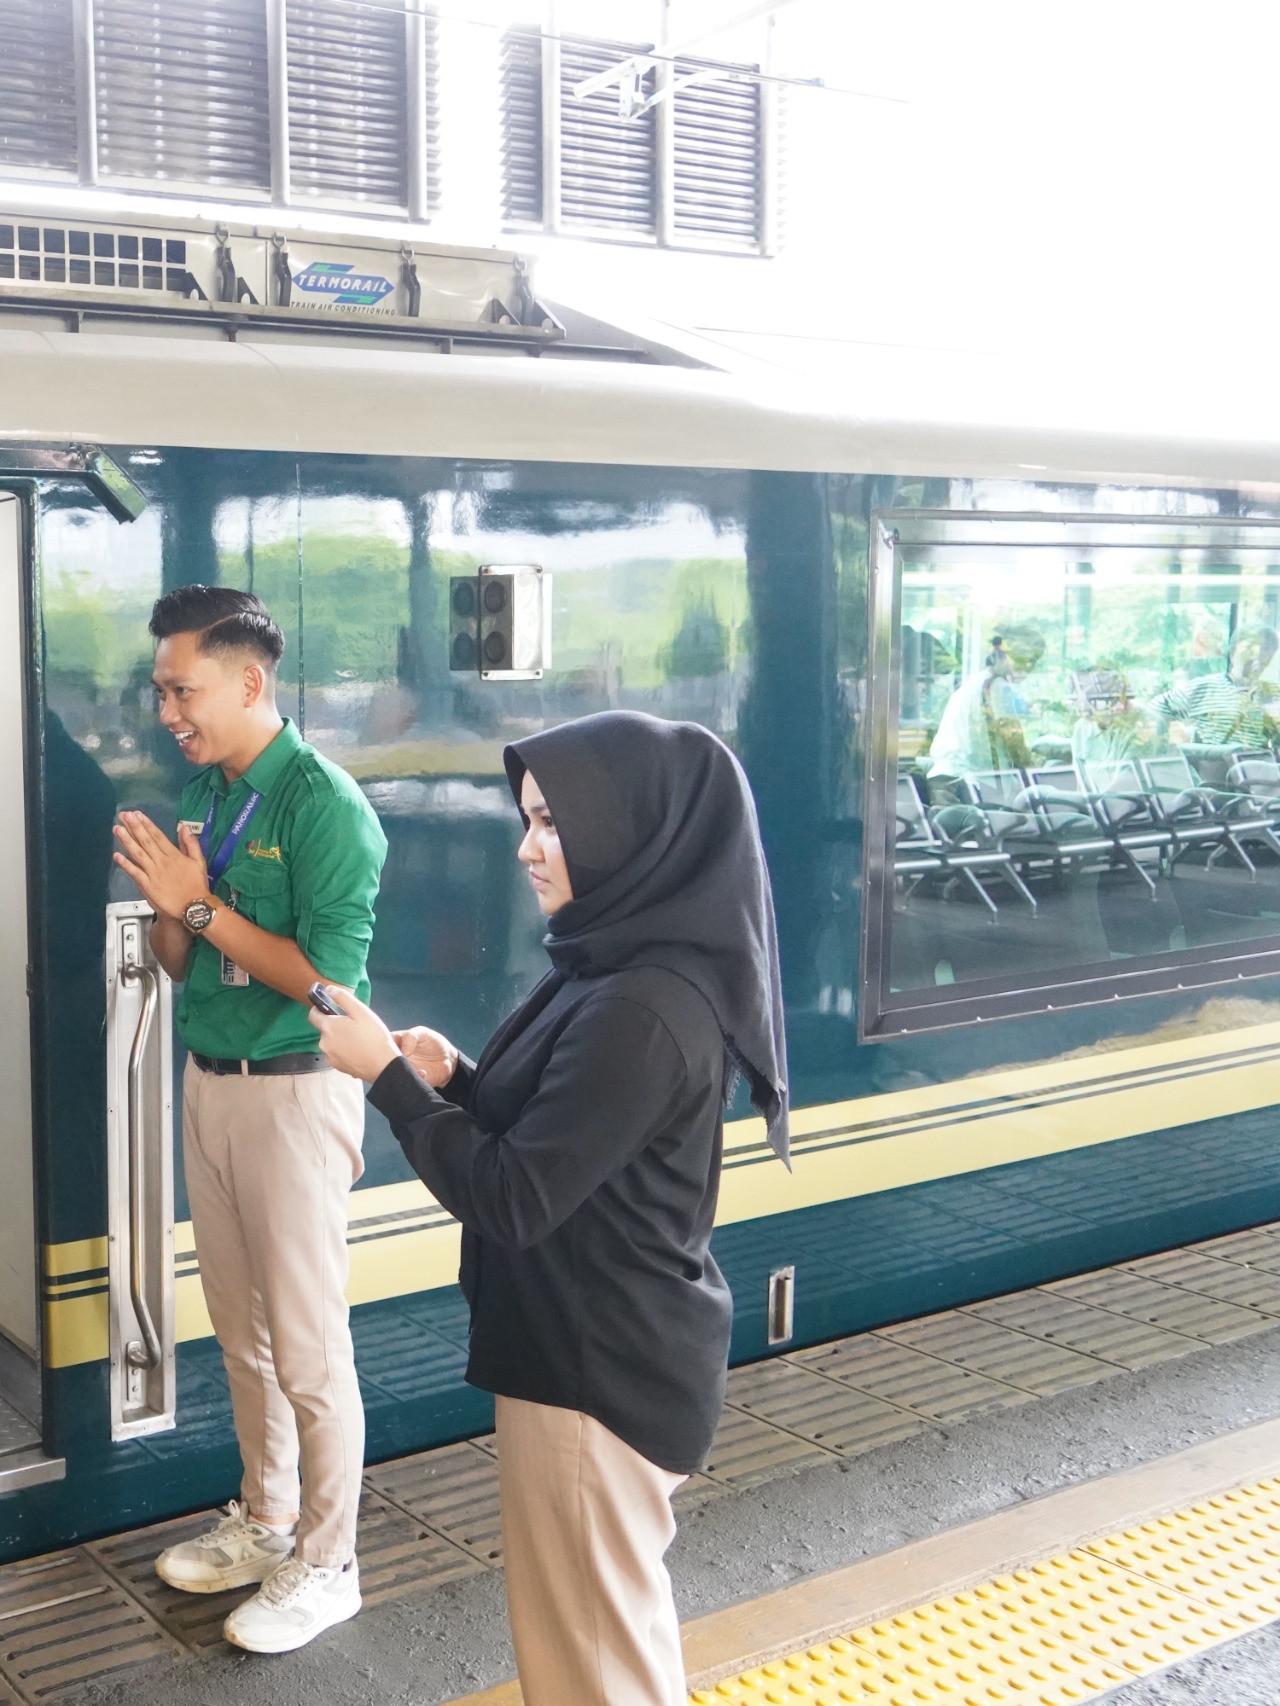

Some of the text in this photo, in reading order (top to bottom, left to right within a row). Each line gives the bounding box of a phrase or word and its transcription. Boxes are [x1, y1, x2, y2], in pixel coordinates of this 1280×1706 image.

[298, 274, 388, 293] TERMORAIL
[290, 301, 396, 316] TRAIN AIR CONDITIONING
[232, 792, 259, 835] PANORAMIC
